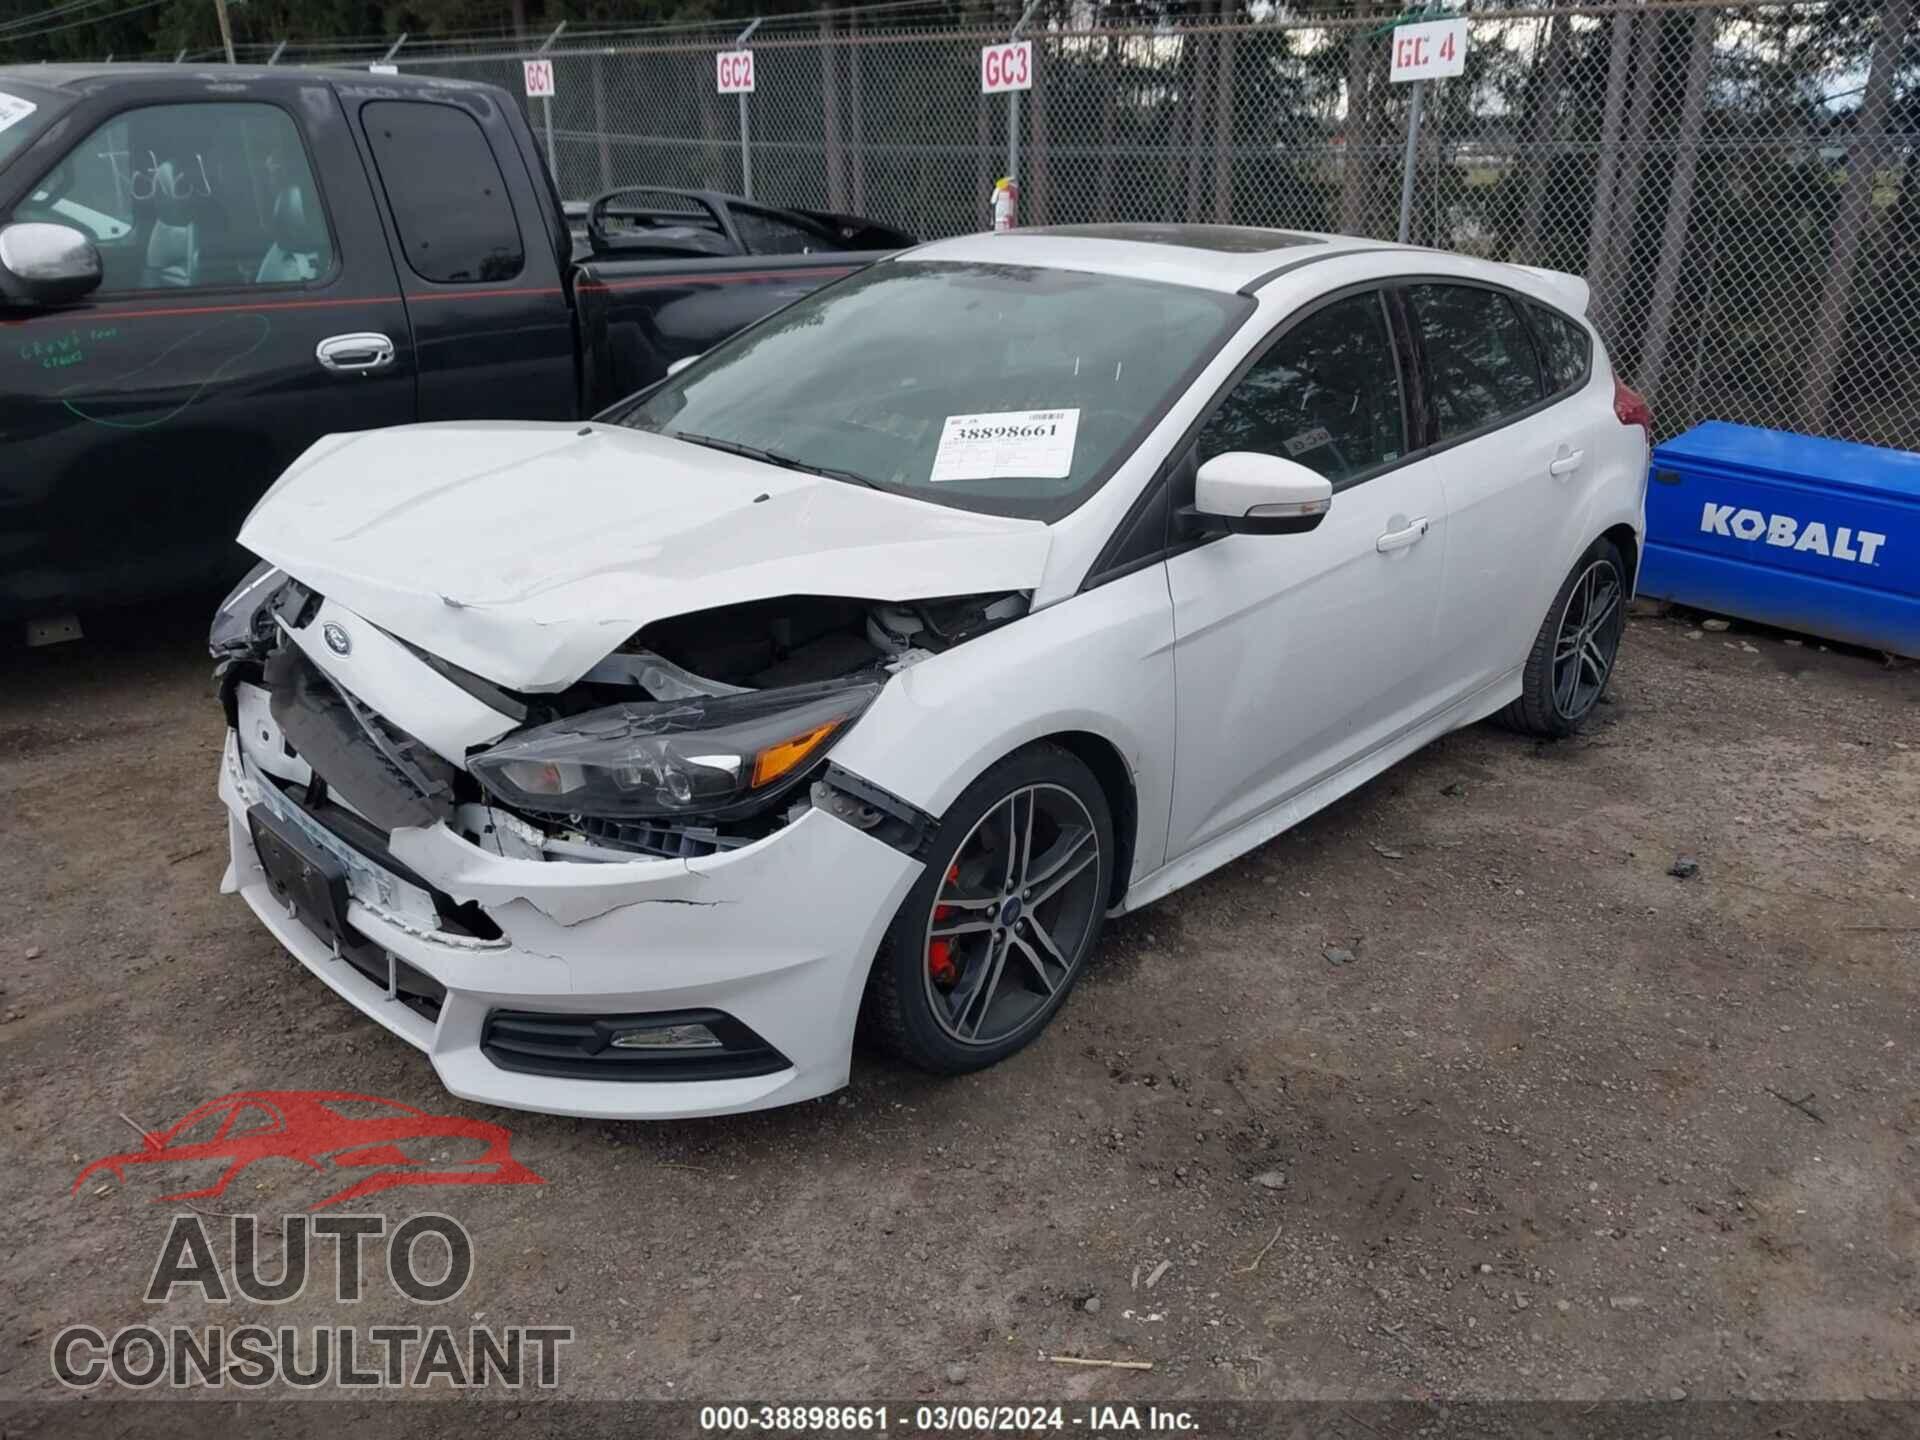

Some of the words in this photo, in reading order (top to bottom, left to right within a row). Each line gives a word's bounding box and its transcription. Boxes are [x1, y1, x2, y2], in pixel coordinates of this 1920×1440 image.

[986, 47, 1027, 86] GC3
[1397, 36, 1430, 68] GC
[1439, 32, 1456, 61] 4
[527, 63, 551, 91] GC1
[720, 56, 752, 88] GC2
[957, 424, 1057, 439] 38898661
[1700, 501, 1887, 565] KOBALT
